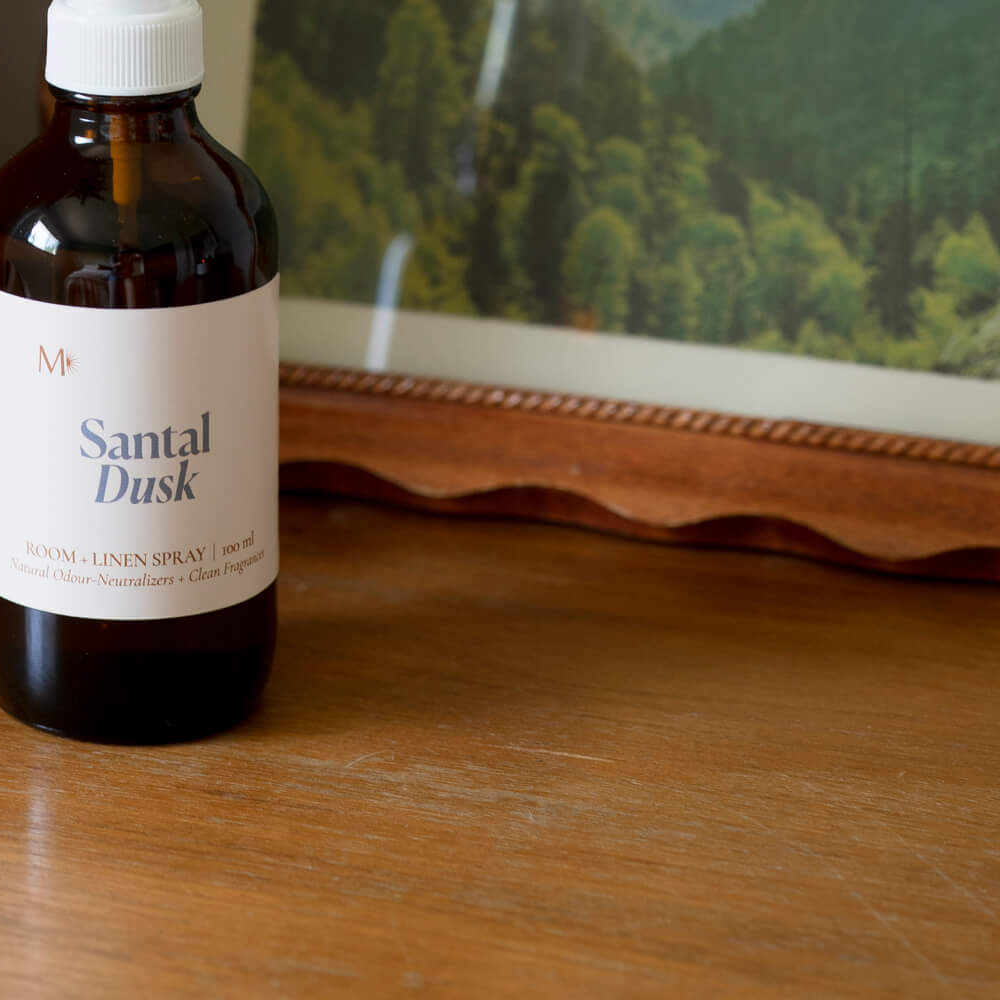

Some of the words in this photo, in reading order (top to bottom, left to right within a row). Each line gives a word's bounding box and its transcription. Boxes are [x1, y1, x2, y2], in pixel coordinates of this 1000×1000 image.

[80, 411, 211, 460] Santal
[94, 459, 199, 505] Dusk
[25, 540, 76, 564] ROOM
[93, 552, 147, 568] LINEN
[152, 547, 206, 567] SPRAY
[221, 543, 240, 556] 100
[242, 529, 254, 549] ml
[10, 557, 49, 578] Natural
[53, 568, 174, 587] Odour-Neutralizers
[189, 564, 221, 582] Clean
